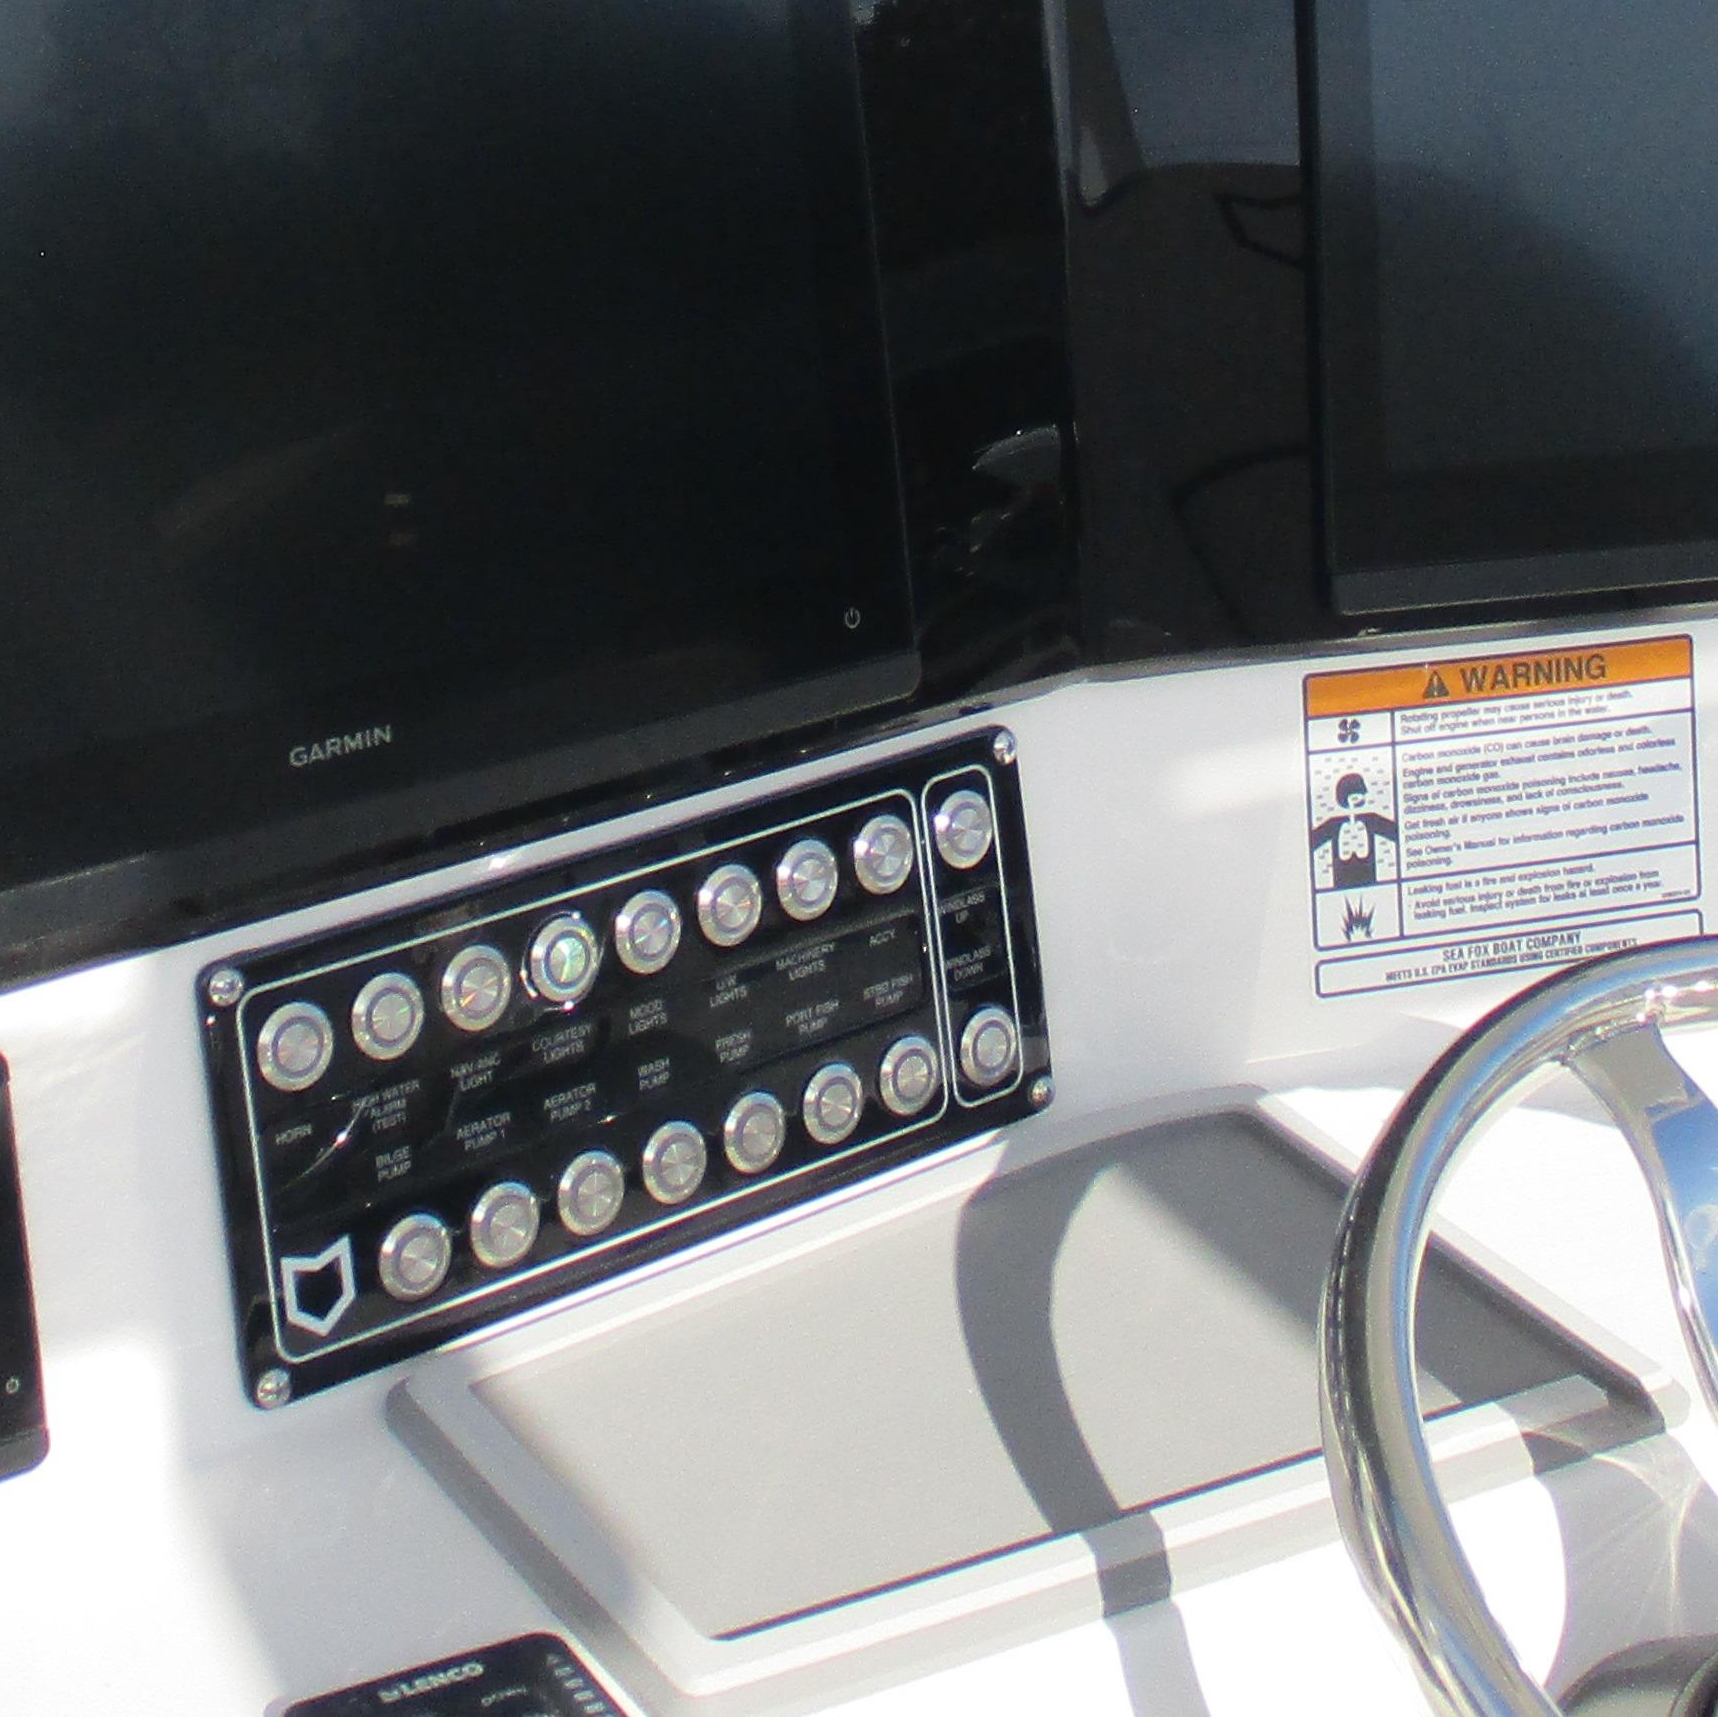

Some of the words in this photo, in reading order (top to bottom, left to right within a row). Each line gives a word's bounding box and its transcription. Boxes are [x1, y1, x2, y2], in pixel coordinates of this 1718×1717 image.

[1460, 653, 1607, 694] WARNING
[289, 723, 393, 769] GARMIN
[1483, 743, 1503, 754] (CO)
[1442, 948, 1464, 961] SEA
[1467, 945, 1489, 958] FOX
[1493, 940, 1522, 954] BOAT
[1526, 932, 1581, 950] COMPANY
[1385, 969, 1412, 980] MEETS
[1431, 965, 1446, 974] EPA
[629, 1012, 668, 1035] LIGHTS
[533, 1024, 593, 1053] COURTESY
[543, 1040, 584, 1064] LIGHTS
[543, 1082, 597, 1110] AERATOR
[550, 1102, 582, 1123] PUMP
[584, 1100, 591, 1112] 2
[275, 1124, 312, 1146] HORN
[456, 1111, 512, 1140] AERATOR
[375, 1146, 411, 1166] BILGE
[400, 1660, 484, 1698] LENCO
